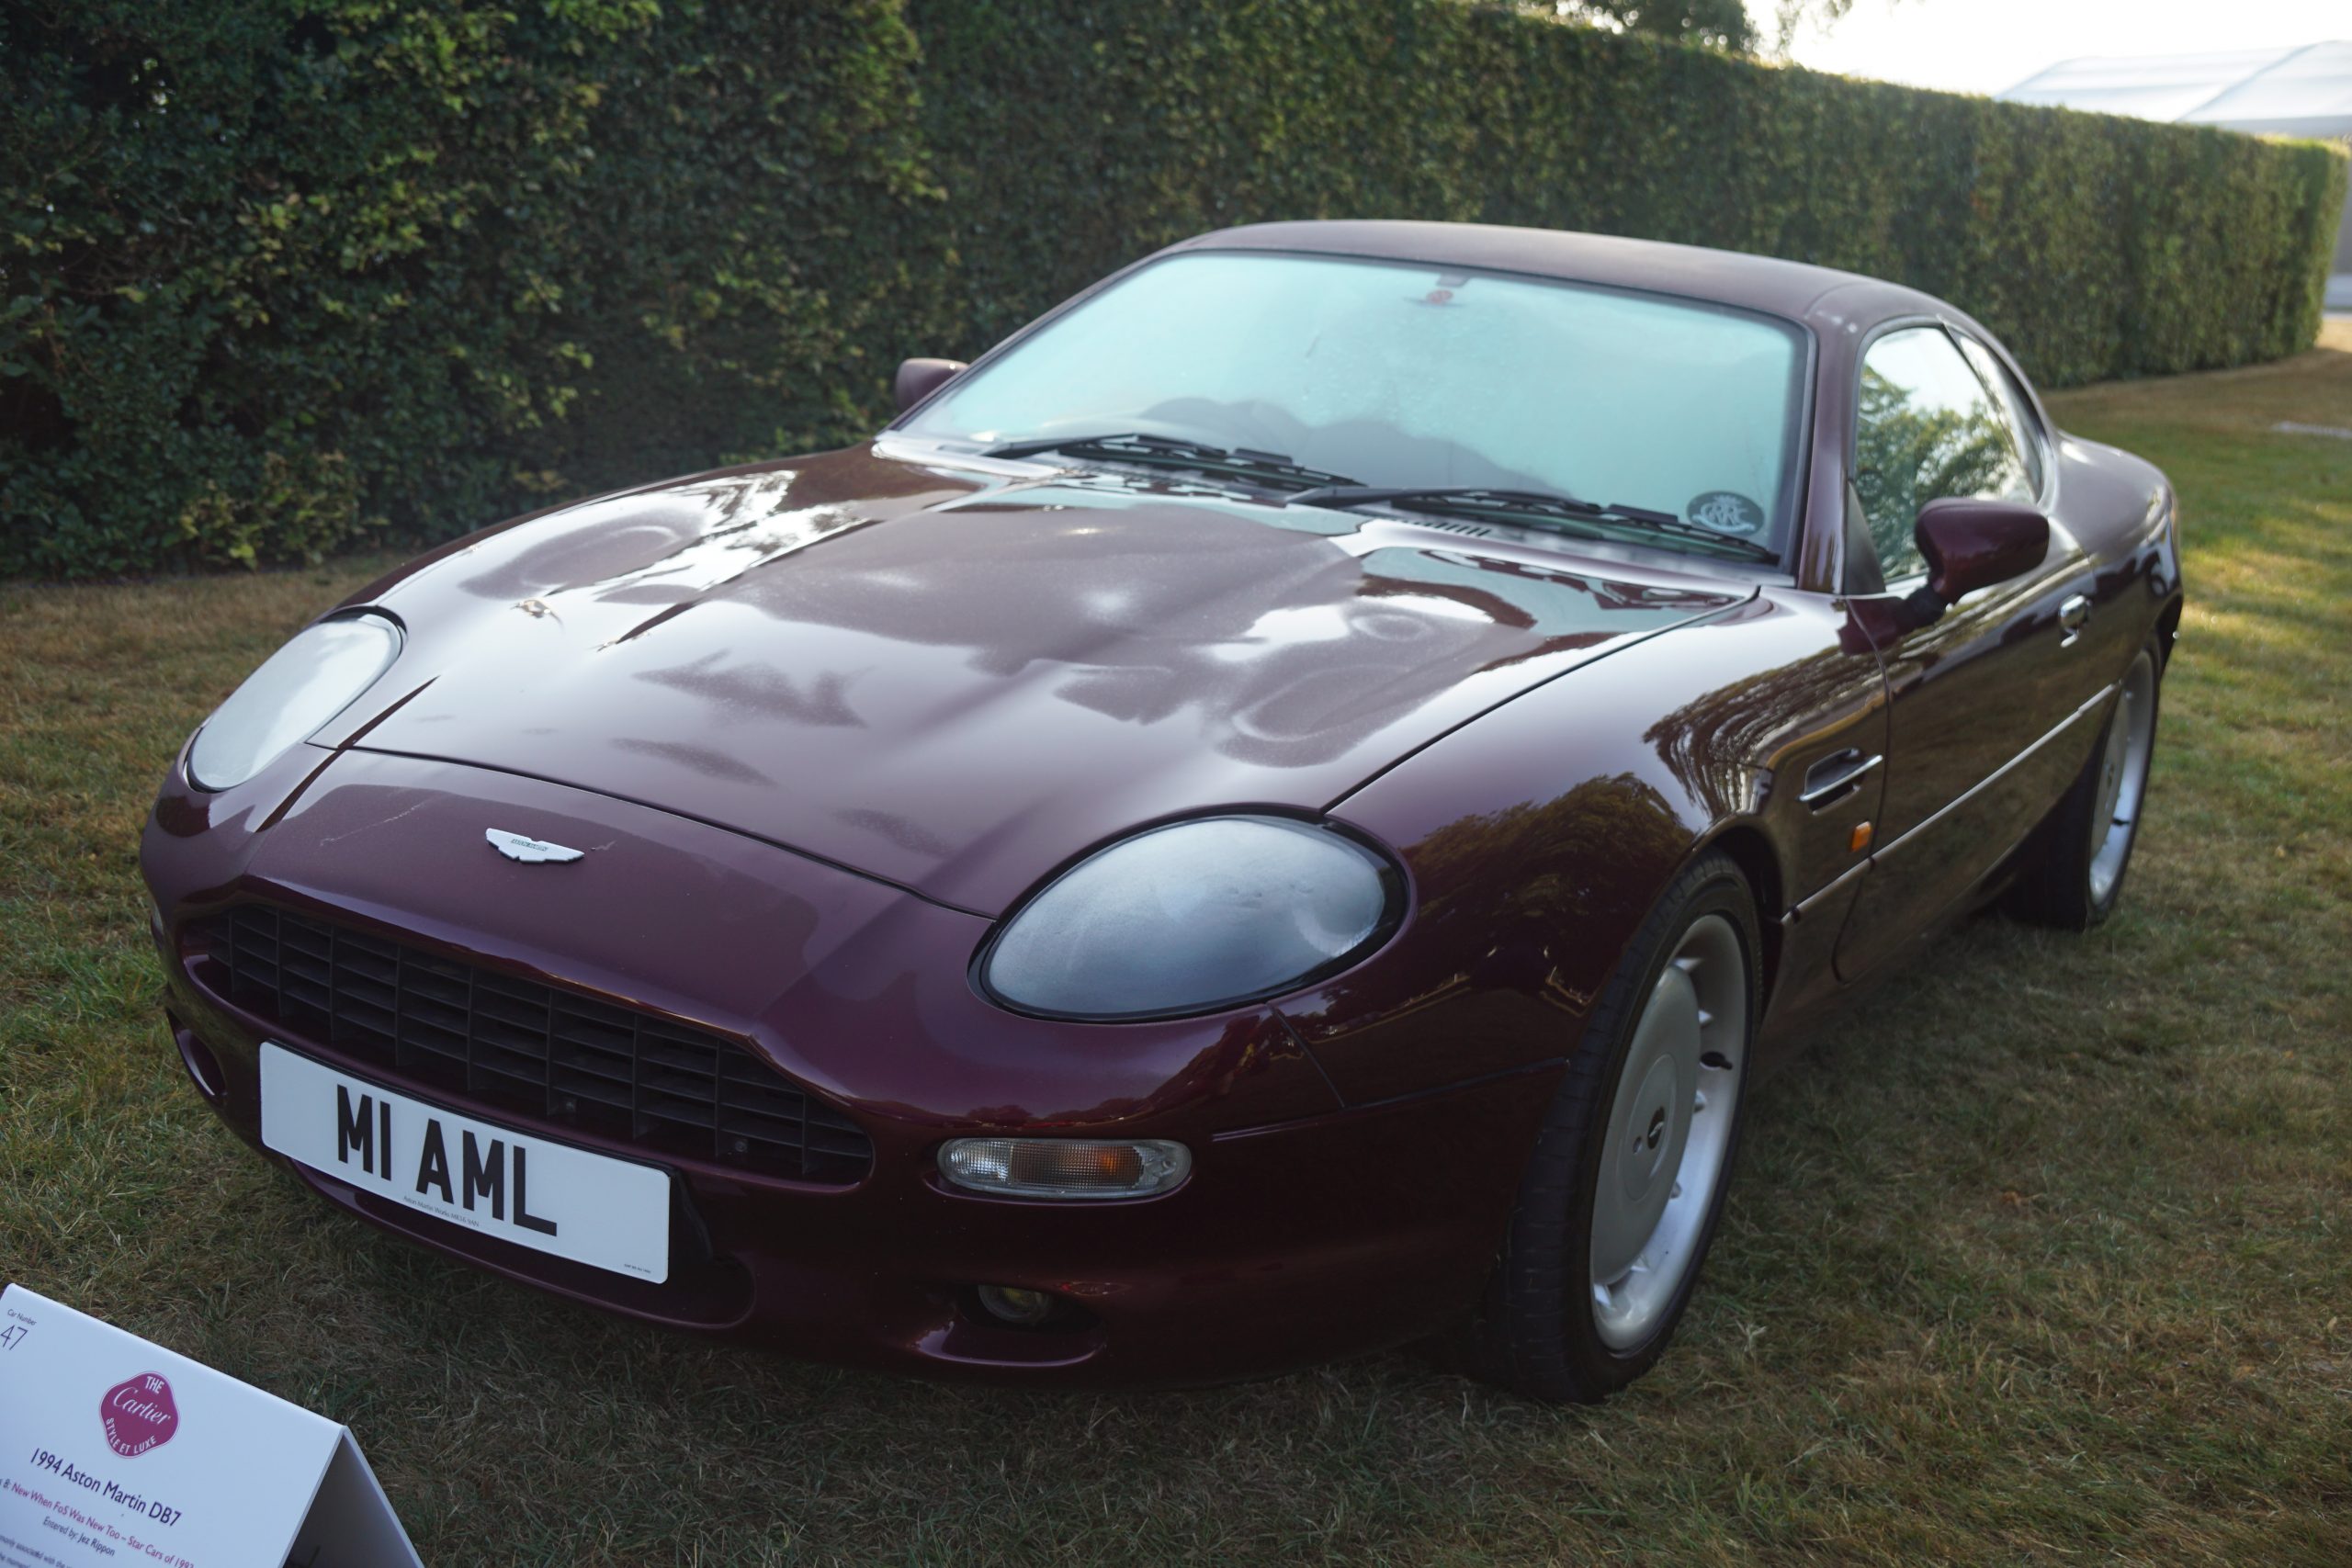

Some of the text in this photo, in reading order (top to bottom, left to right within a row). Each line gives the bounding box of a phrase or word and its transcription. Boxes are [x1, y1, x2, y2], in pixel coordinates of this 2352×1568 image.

[415, 1118, 558, 1237] AML
[7, 1308, 37, 1325] Car Number
[1, 1325, 28, 1350] 47
[145, 1376, 164, 1394] THE
[113, 1386, 172, 1425] Cartier
[106, 1417, 157, 1454] STYLE ET LUXE
[30, 1447, 182, 1527] 1994 Aston Martin DB7
[11, 1483, 29, 1498] New
[30, 1490, 53, 1508] When
[52, 1501, 69, 1516] FoS
[69, 1507, 85, 1523] Was
[85, 1517, 105, 1532] New
[106, 1524, 120, 1540] Too
[127, 1535, 144, 1550] Star
[145, 1543, 164, 1560] Cars
[164, 1554, 175, 1564] of
[42, 1516, 69, 1535] Entered
[77, 1532, 91, 1544] Jez
[91, 1538, 115, 1556] Rippon
